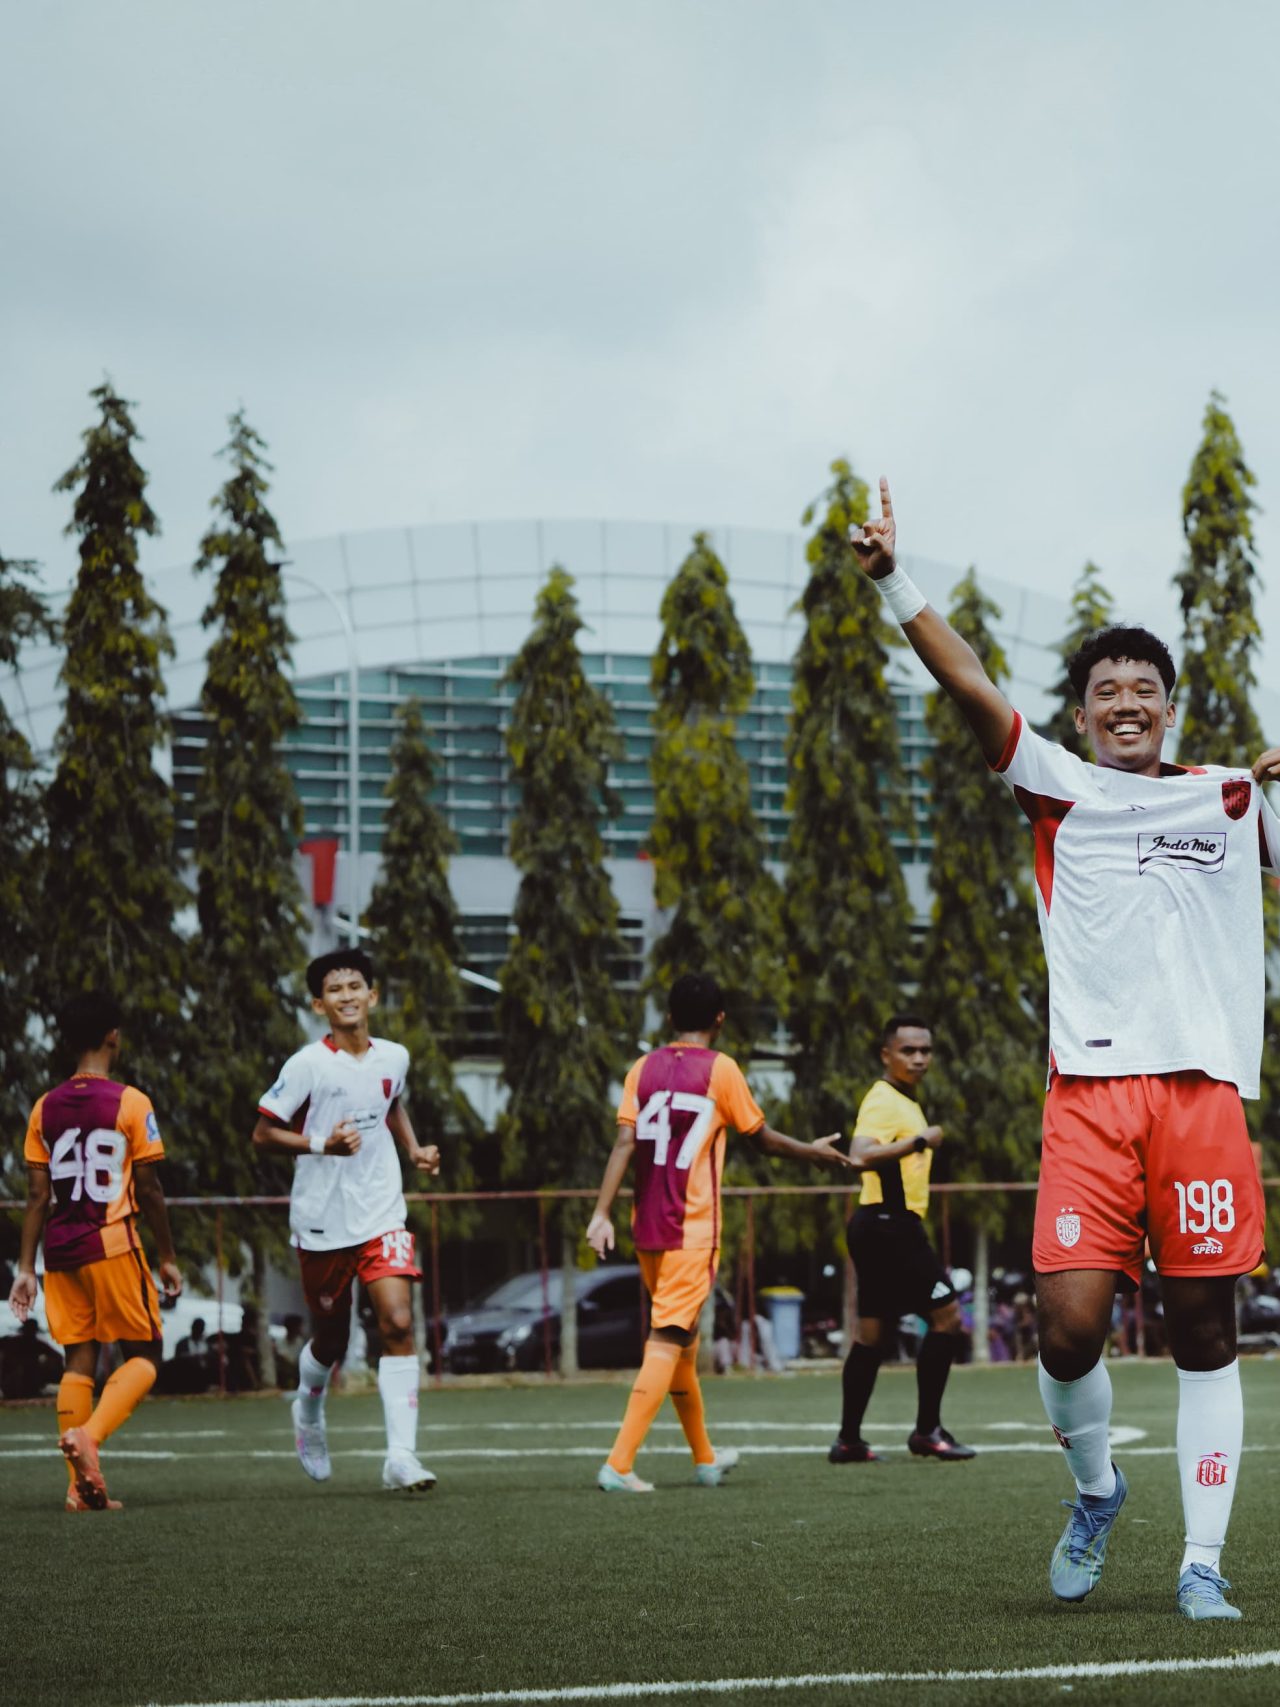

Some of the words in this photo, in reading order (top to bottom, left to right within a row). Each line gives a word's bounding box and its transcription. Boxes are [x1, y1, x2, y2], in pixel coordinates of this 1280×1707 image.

[636, 1089, 716, 1170] 47
[50, 1127, 128, 1203] 48
[1174, 1179, 1236, 1234] 198
[1192, 1245, 1223, 1255] SPECS
